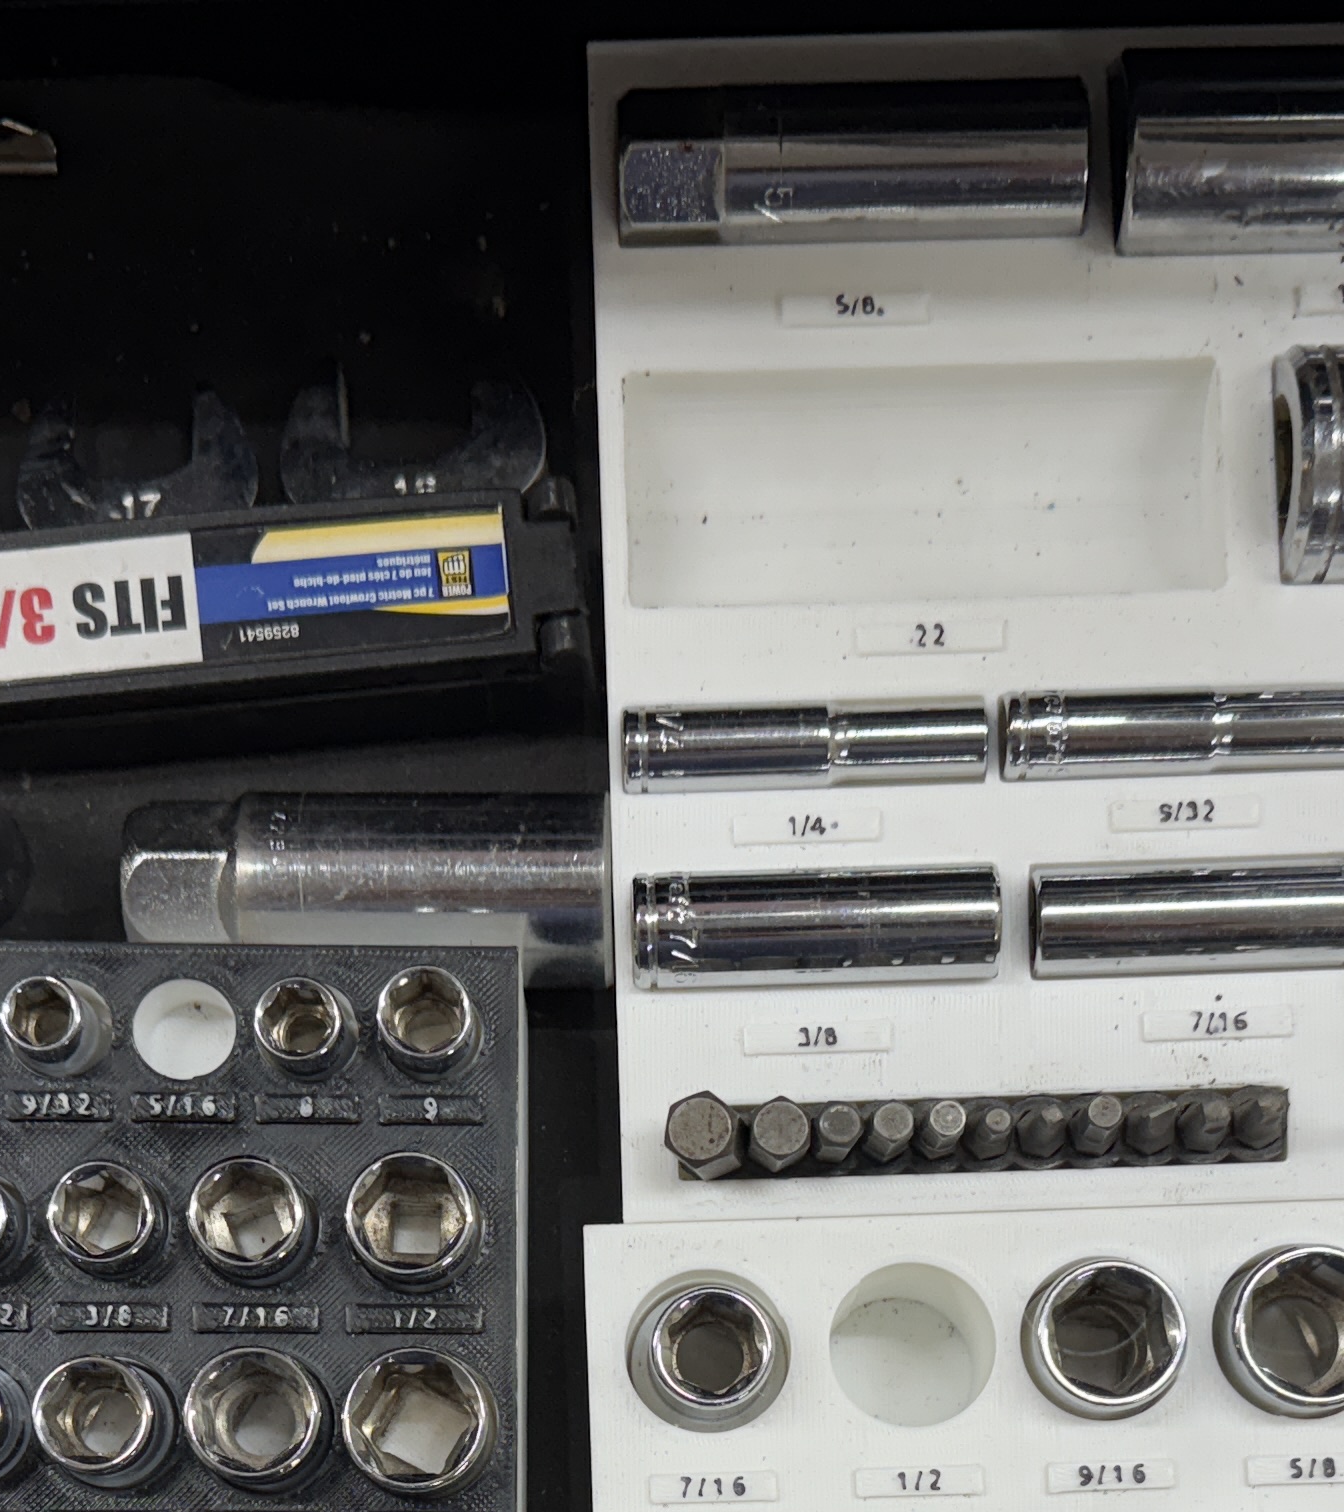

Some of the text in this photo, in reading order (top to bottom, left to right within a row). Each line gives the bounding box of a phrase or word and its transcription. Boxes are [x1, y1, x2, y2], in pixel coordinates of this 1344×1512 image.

[328, 591, 377, 607] Crowfoot
[378, 588, 412, 604] Metric
[441, 584, 472, 596] POWER
[77, 574, 186, 639] FITS
[287, 596, 328, 610] Wrench
[238, 623, 300, 643] 8259541
[916, 624, 944, 647] 22
[1079, 1464, 1145, 1486] 9/16
[1290, 1457, 1335, 1479] 5/8
[681, 1476, 745, 1498] 7/16
[898, 1469, 940, 1490] 1/2
